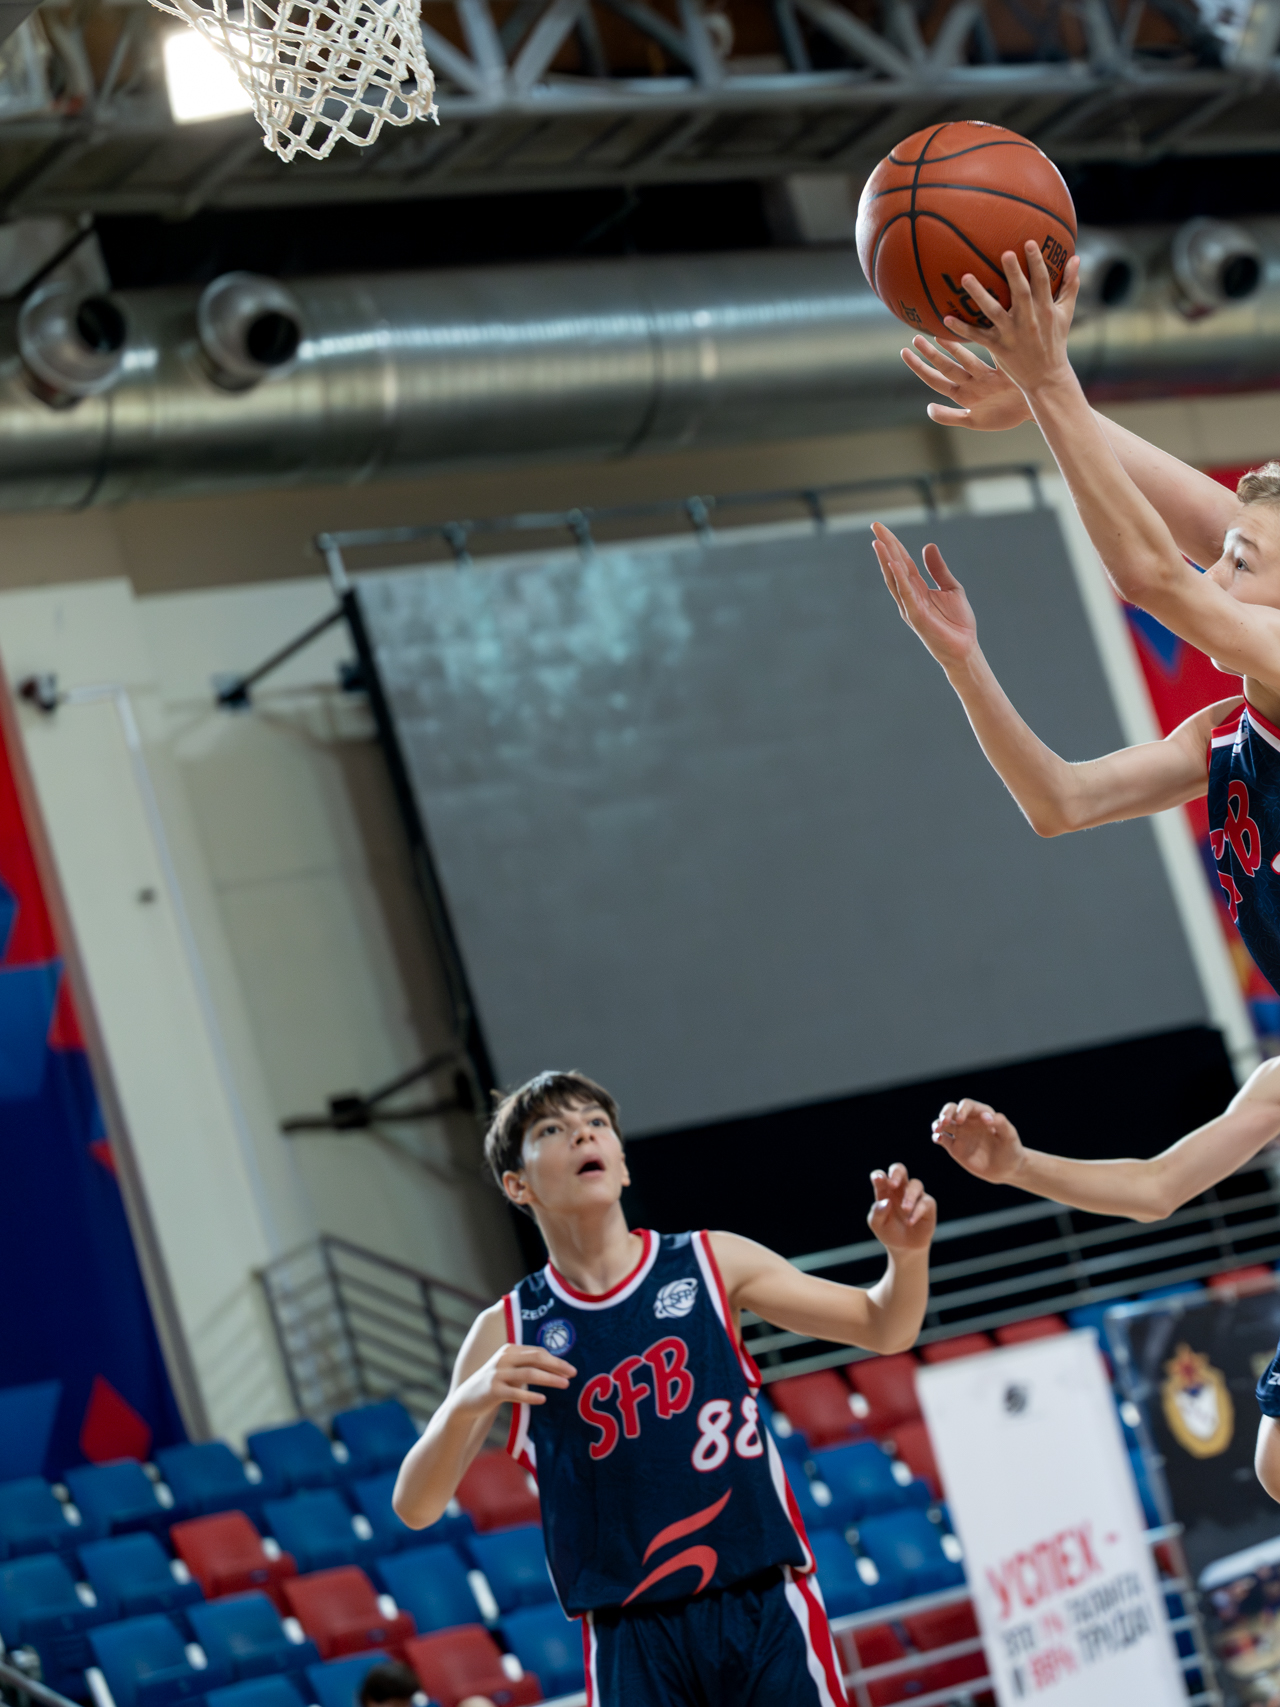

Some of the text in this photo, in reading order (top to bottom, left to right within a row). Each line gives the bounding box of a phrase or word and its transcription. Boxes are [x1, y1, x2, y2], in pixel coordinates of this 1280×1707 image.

[1041, 235, 1067, 271] FIBA
[578, 1336, 694, 1460] SFB
[692, 1396, 764, 1472] 88
